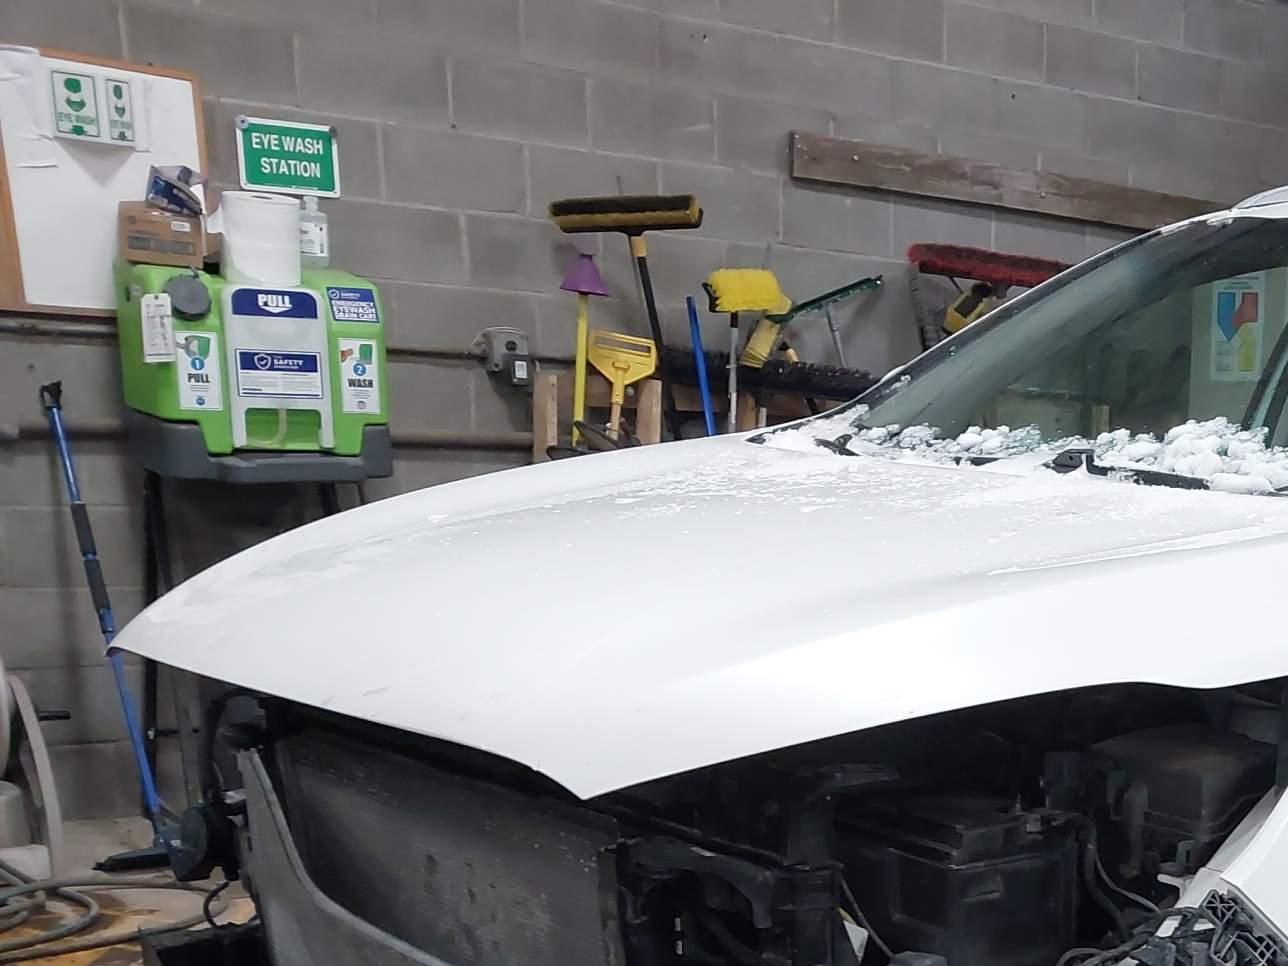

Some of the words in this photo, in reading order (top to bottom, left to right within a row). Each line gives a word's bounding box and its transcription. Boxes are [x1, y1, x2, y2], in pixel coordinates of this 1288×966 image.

[251, 132, 280, 151] EYE
[282, 136, 323, 155] WASH
[260, 157, 320, 178] STATION
[257, 293, 293, 308] PULL
[187, 373, 211, 384] PULL
[347, 378, 374, 389] WASH
